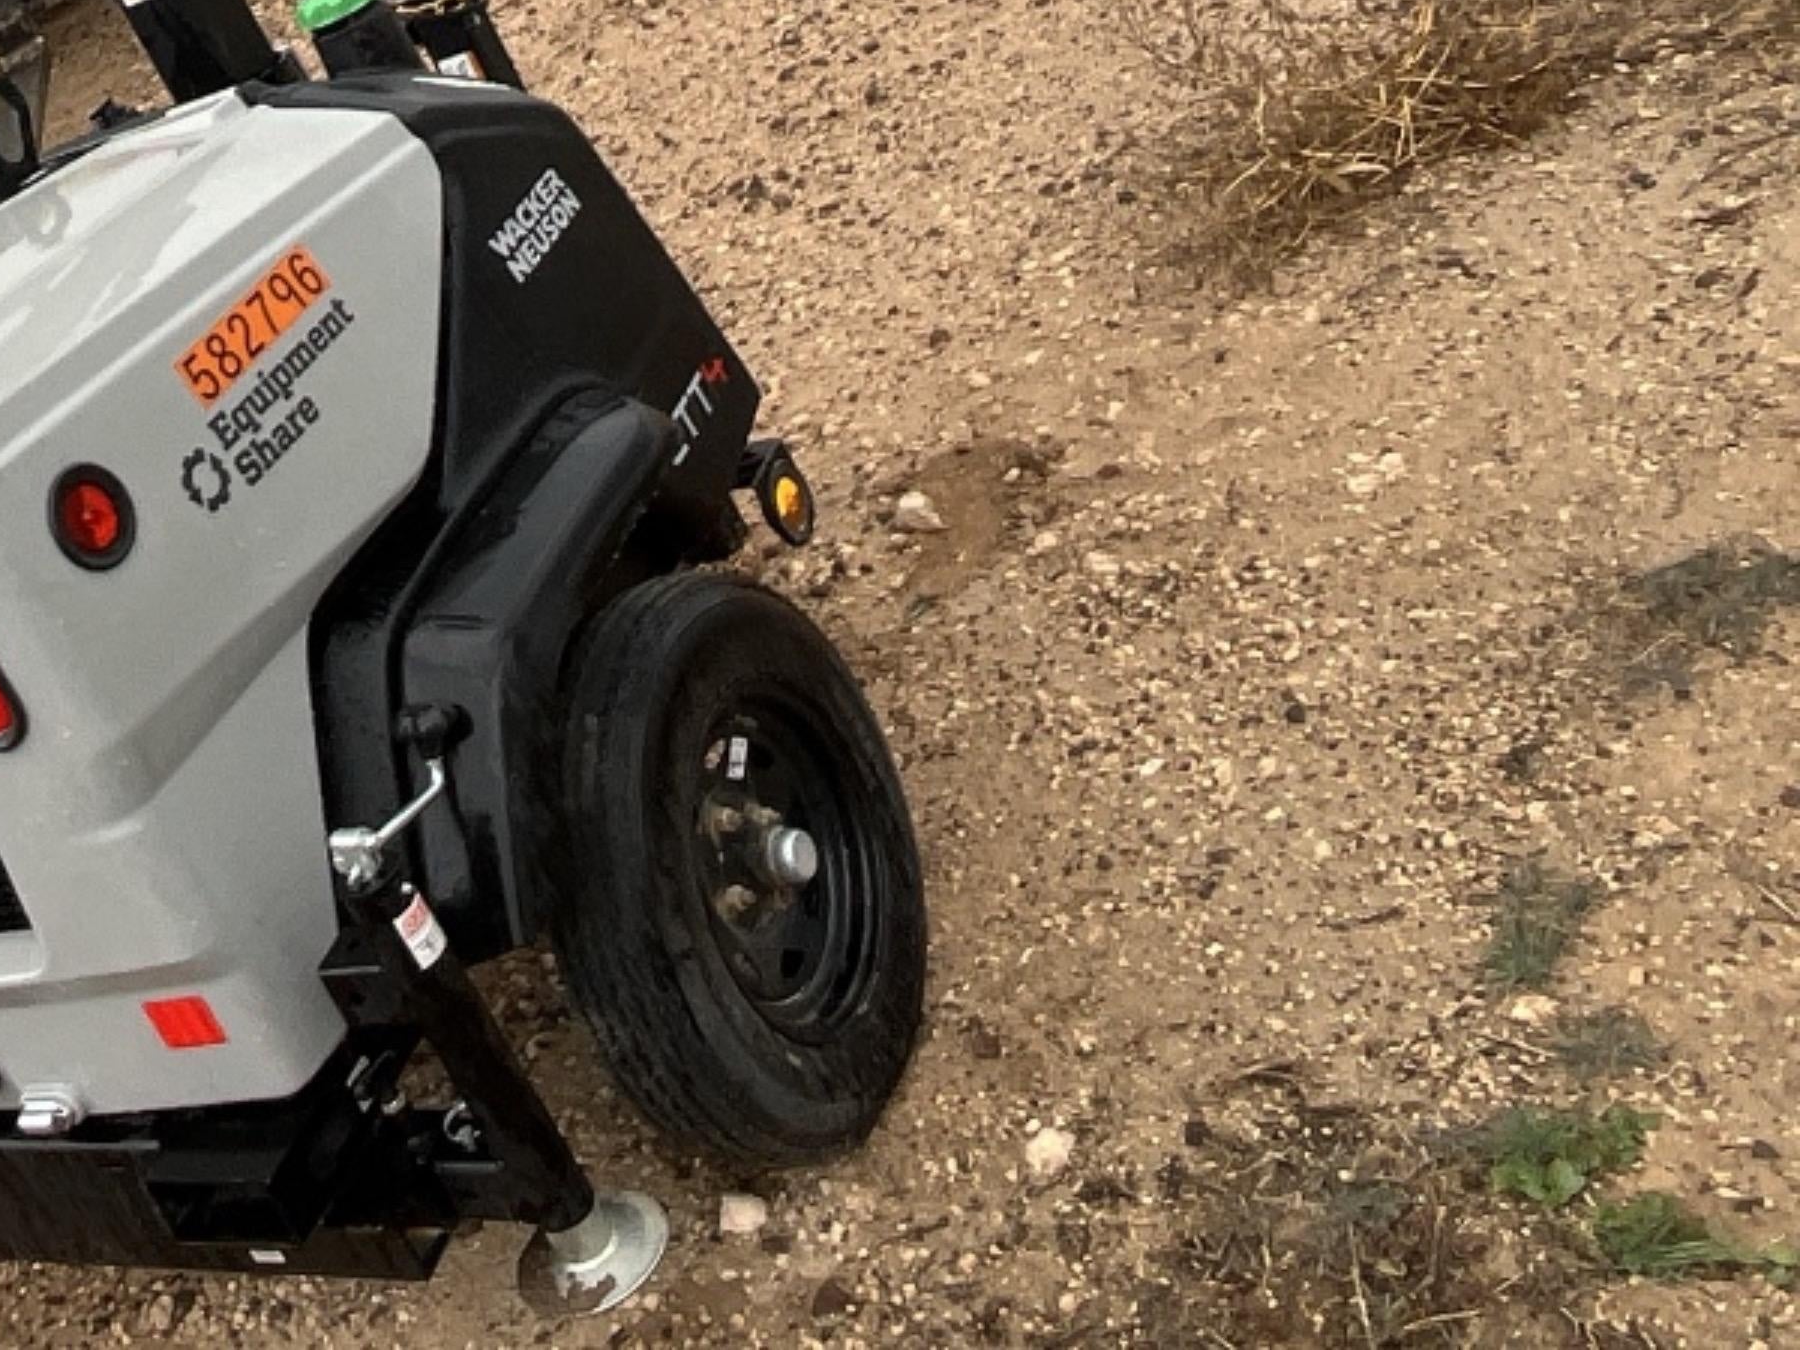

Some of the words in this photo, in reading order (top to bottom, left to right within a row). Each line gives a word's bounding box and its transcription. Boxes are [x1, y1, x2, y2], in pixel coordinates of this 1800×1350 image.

[487, 168, 565, 257] WACKER
[506, 187, 582, 283] NEUSON
[182, 252, 324, 400] 582796
[207, 297, 354, 451] Equipment
[233, 395, 320, 486] Share
